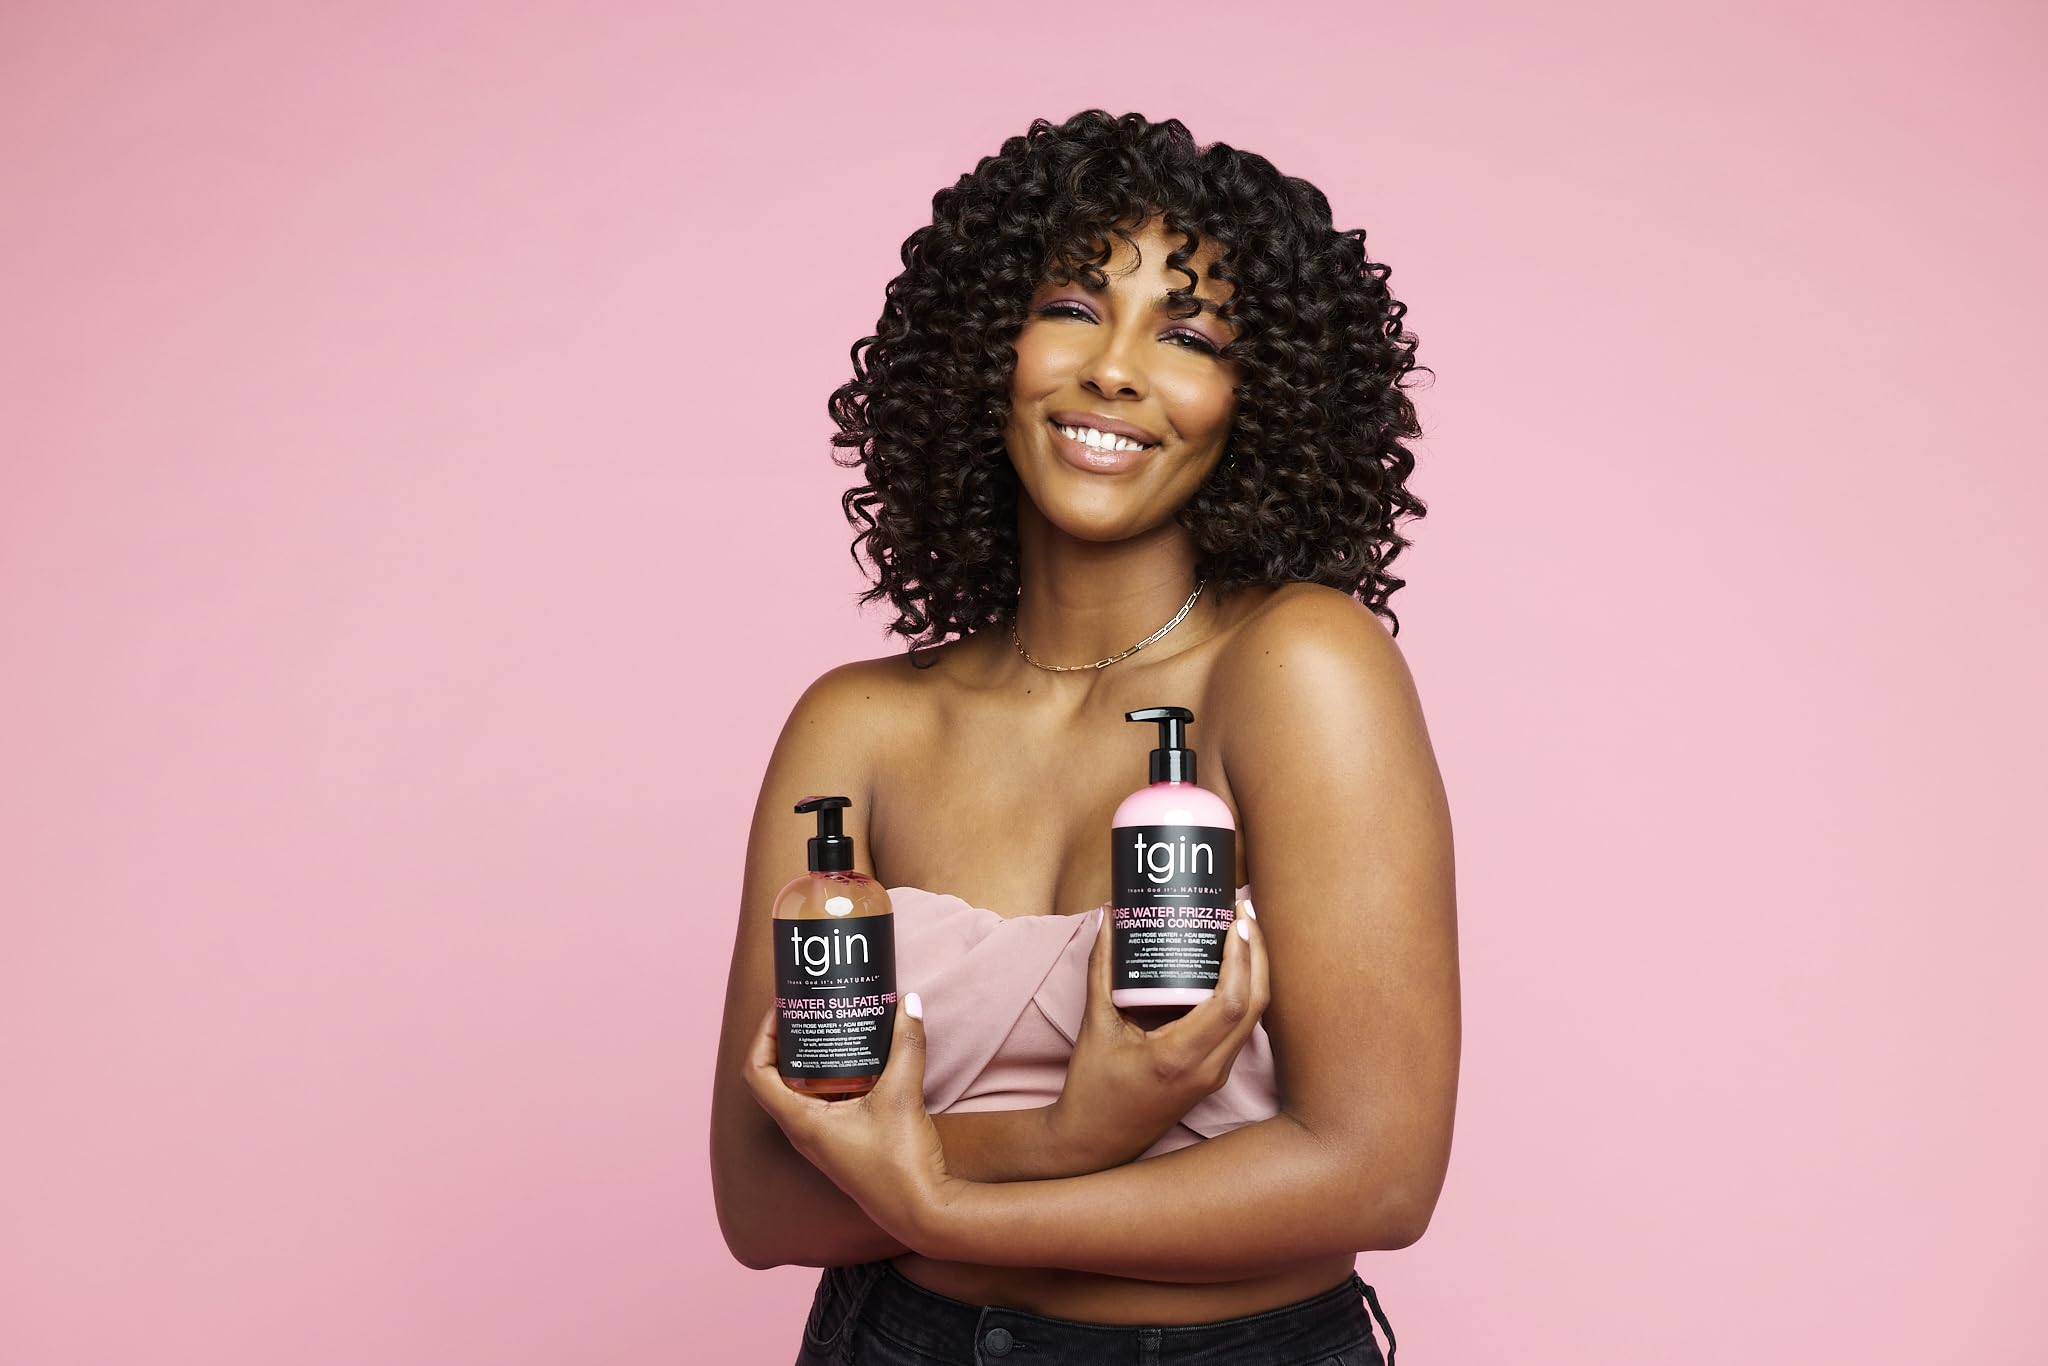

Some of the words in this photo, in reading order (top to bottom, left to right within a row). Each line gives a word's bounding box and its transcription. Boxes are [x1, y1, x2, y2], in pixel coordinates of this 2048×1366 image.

[1134, 833, 1213, 883] tgin
[1132, 907, 1175, 918] WATER
[1179, 907, 1213, 919] FRIZZ
[1215, 909, 1234, 921] FREE
[1116, 919, 1164, 929] HYDRATING
[791, 926, 869, 976] tgin
[1128, 971, 1139, 979] NO
[787, 998, 825, 1009] WATER
[828, 995, 879, 1008] SULFATE
[881, 992, 897, 1004] FREE
[782, 1010, 833, 1019] HYDRATING
[836, 1006, 885, 1019] SHAMPOO
